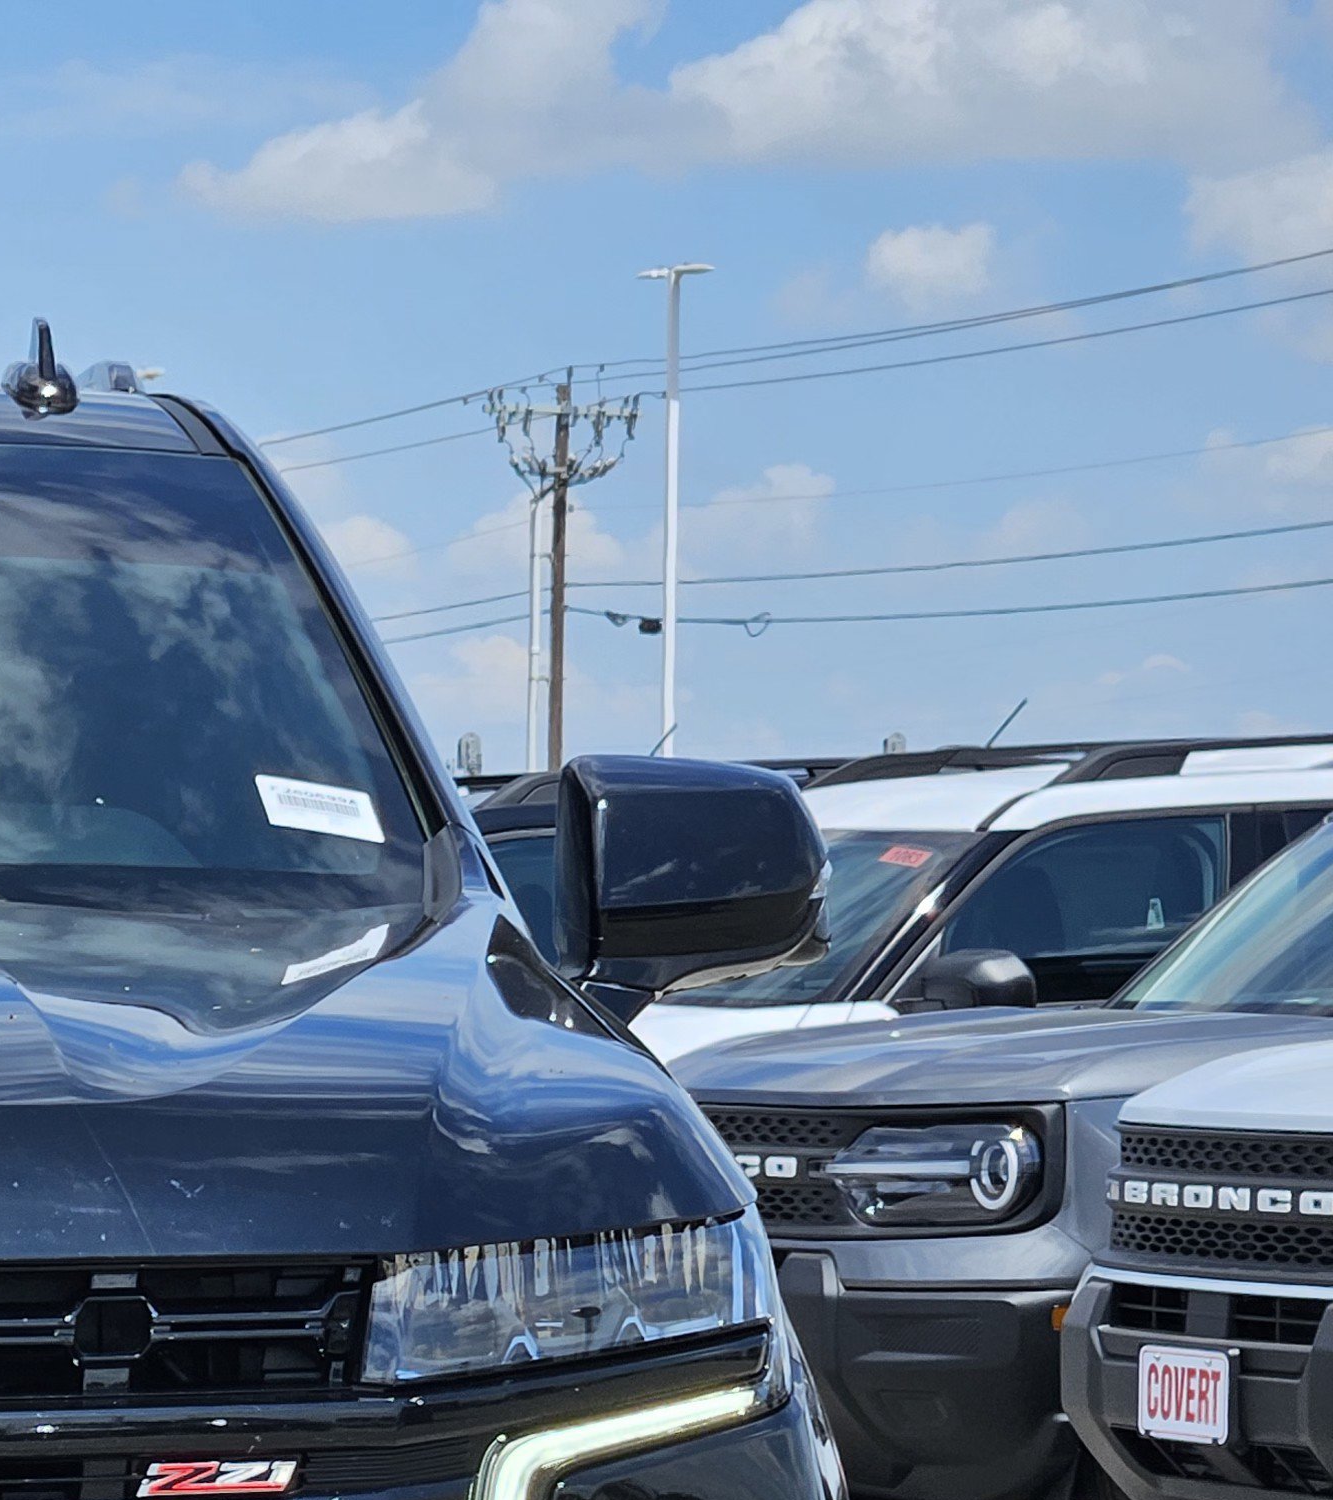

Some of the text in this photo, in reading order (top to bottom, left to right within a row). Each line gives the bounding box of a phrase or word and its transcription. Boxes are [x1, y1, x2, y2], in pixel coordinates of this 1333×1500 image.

[1123, 1180, 1333, 1216] BRONCO
[1147, 1363, 1221, 1426] COVERT
[136, 1460, 298, 1498] Z71
